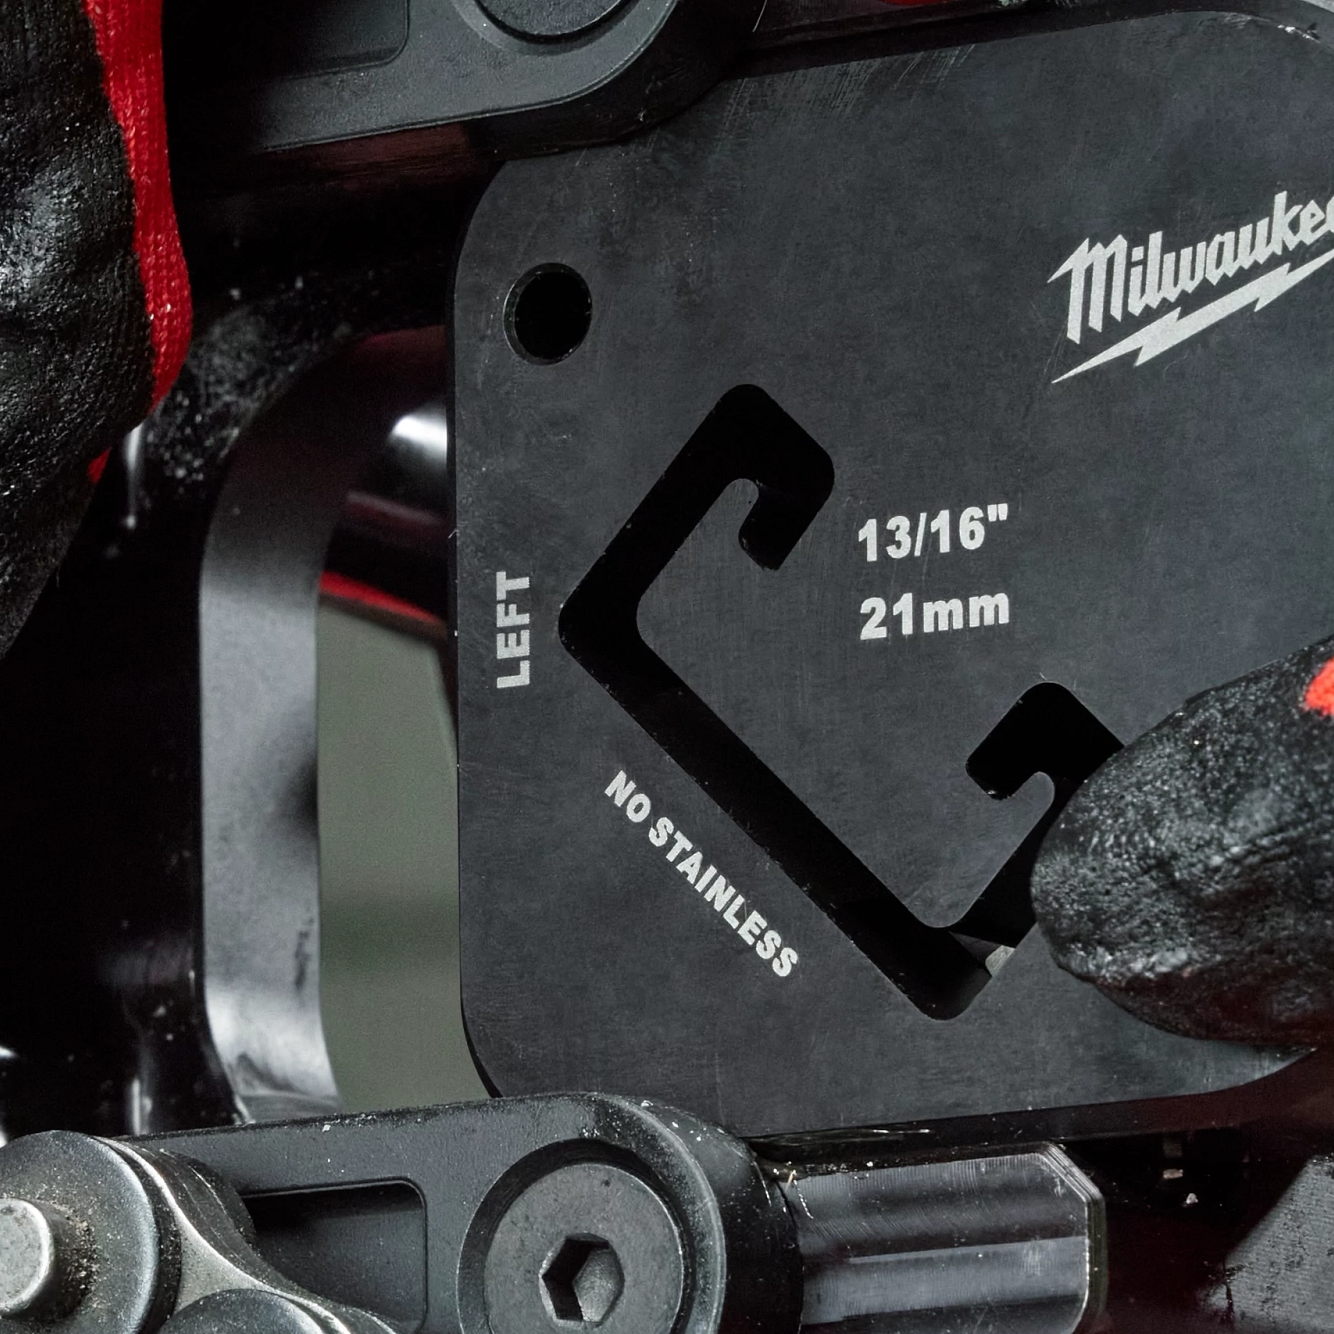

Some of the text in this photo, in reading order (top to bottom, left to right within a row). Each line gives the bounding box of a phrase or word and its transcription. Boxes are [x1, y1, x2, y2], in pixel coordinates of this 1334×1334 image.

[857, 503, 1009, 563] 13/16"
[495, 570, 530, 689] LEFT
[859, 592, 1010, 641] 21mm
[604, 769, 799, 977] NO STAINLESS
